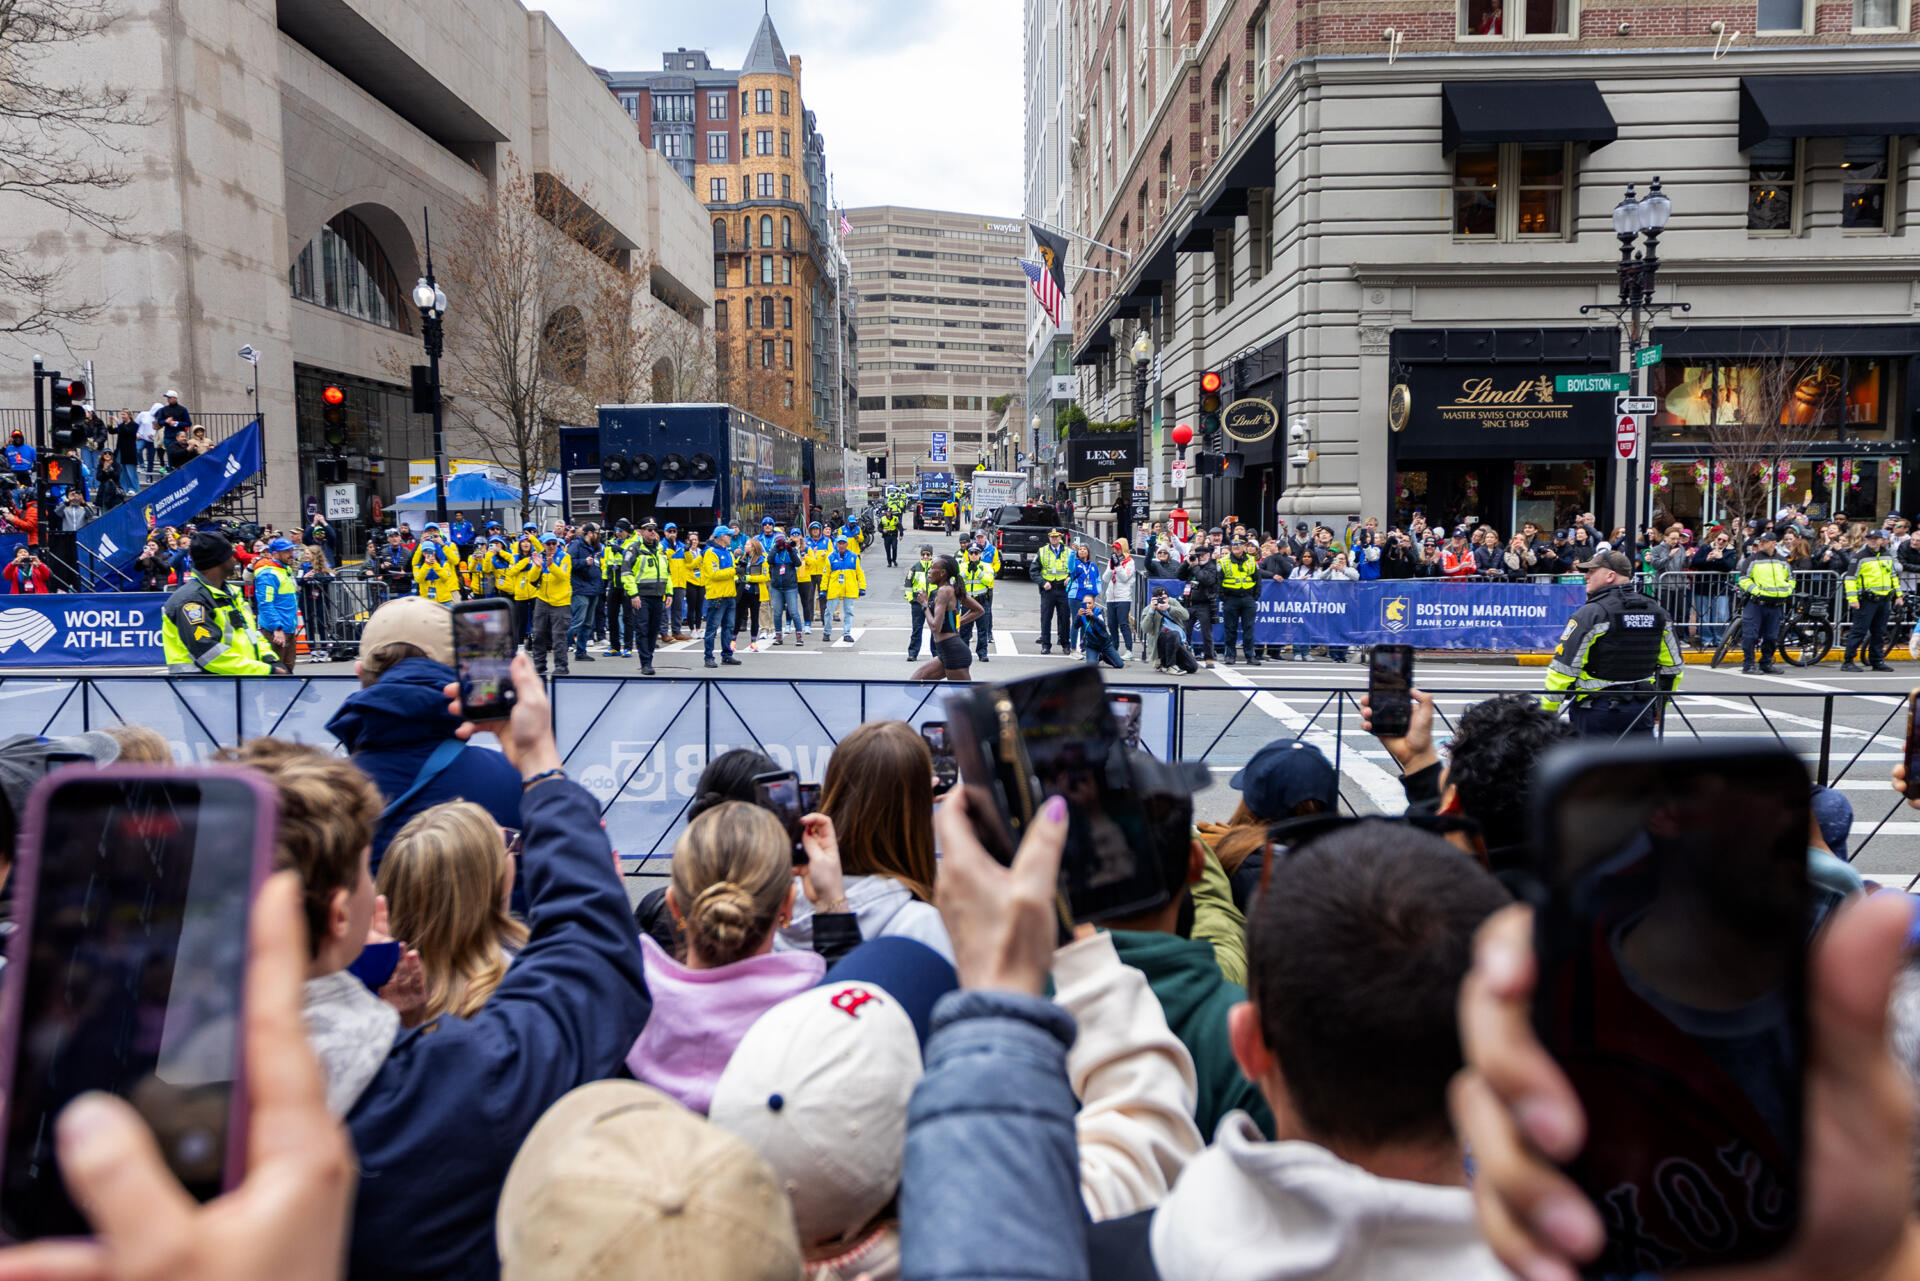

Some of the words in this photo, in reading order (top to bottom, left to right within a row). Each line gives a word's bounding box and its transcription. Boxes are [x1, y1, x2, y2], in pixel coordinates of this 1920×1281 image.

[993, 223, 1022, 234] wayfair
[1567, 378, 1611, 392] BOYLSTON
[1454, 378, 1534, 404] Lindt
[1443, 411, 1476, 420] MASTER
[1478, 411, 1504, 419] SWISS
[1505, 410, 1568, 419] CHOCOLATIER
[1230, 414, 1263, 427] Lindt
[1482, 420, 1507, 428] SINCE
[1509, 420, 1530, 428] 1845
[1620, 442, 1632, 450] ENTER
[1086, 450, 1127, 460] LENOX
[925, 481, 949, 489] 2:18:36
[155, 495, 174, 512] BOSTON
[173, 478, 199, 500] MARATHON
[335, 488, 346, 496] NO
[332, 498, 351, 506] TURN
[1218, 601, 1270, 613] BON
[1273, 601, 1346, 614] MARATHON
[1416, 603, 1469, 616] BOSTON
[1472, 604, 1547, 618] MARATHON
[63, 610, 144, 628] WORLD
[1260, 616, 1304, 624] AMERICA
[1416, 619, 1441, 627] BANK
[1444, 619, 1457, 627] OF
[1626, 620, 1654, 628] POLICE
[63, 630, 164, 648] ATHLETIC
